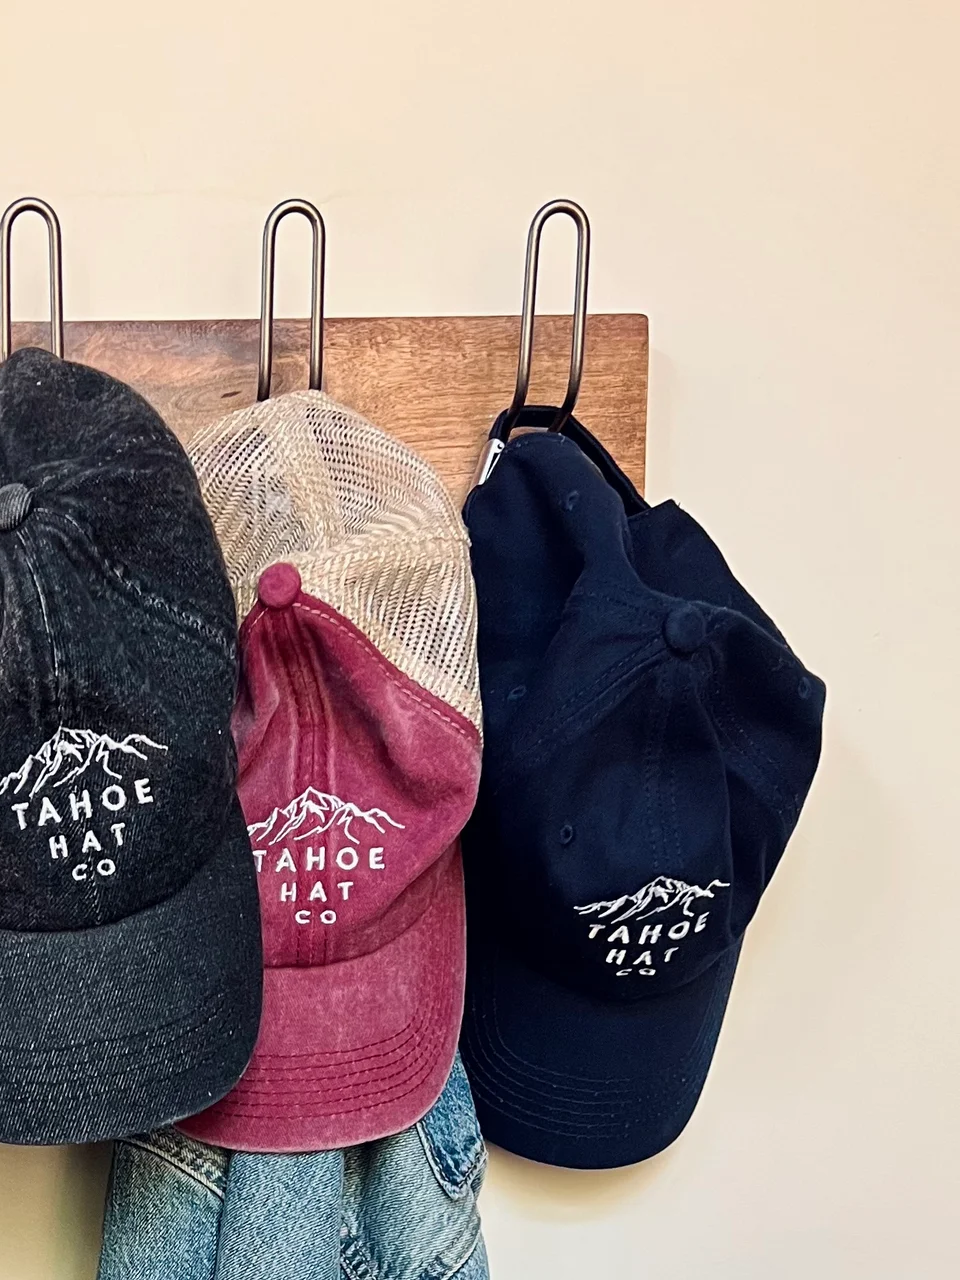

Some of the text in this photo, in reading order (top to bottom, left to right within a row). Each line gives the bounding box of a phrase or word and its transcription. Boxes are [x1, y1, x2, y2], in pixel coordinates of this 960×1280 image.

[10, 777, 155, 831] TAHOE
[48, 822, 126, 860] HAT
[71, 858, 117, 882] CO
[251, 846, 386, 873] TAHOE
[280, 880, 354, 903] HAT
[295, 909, 338, 925] CO
[588, 911, 711, 945] TAHOE
[605, 946, 680, 966] HAT
[615, 968, 657, 977] CO
